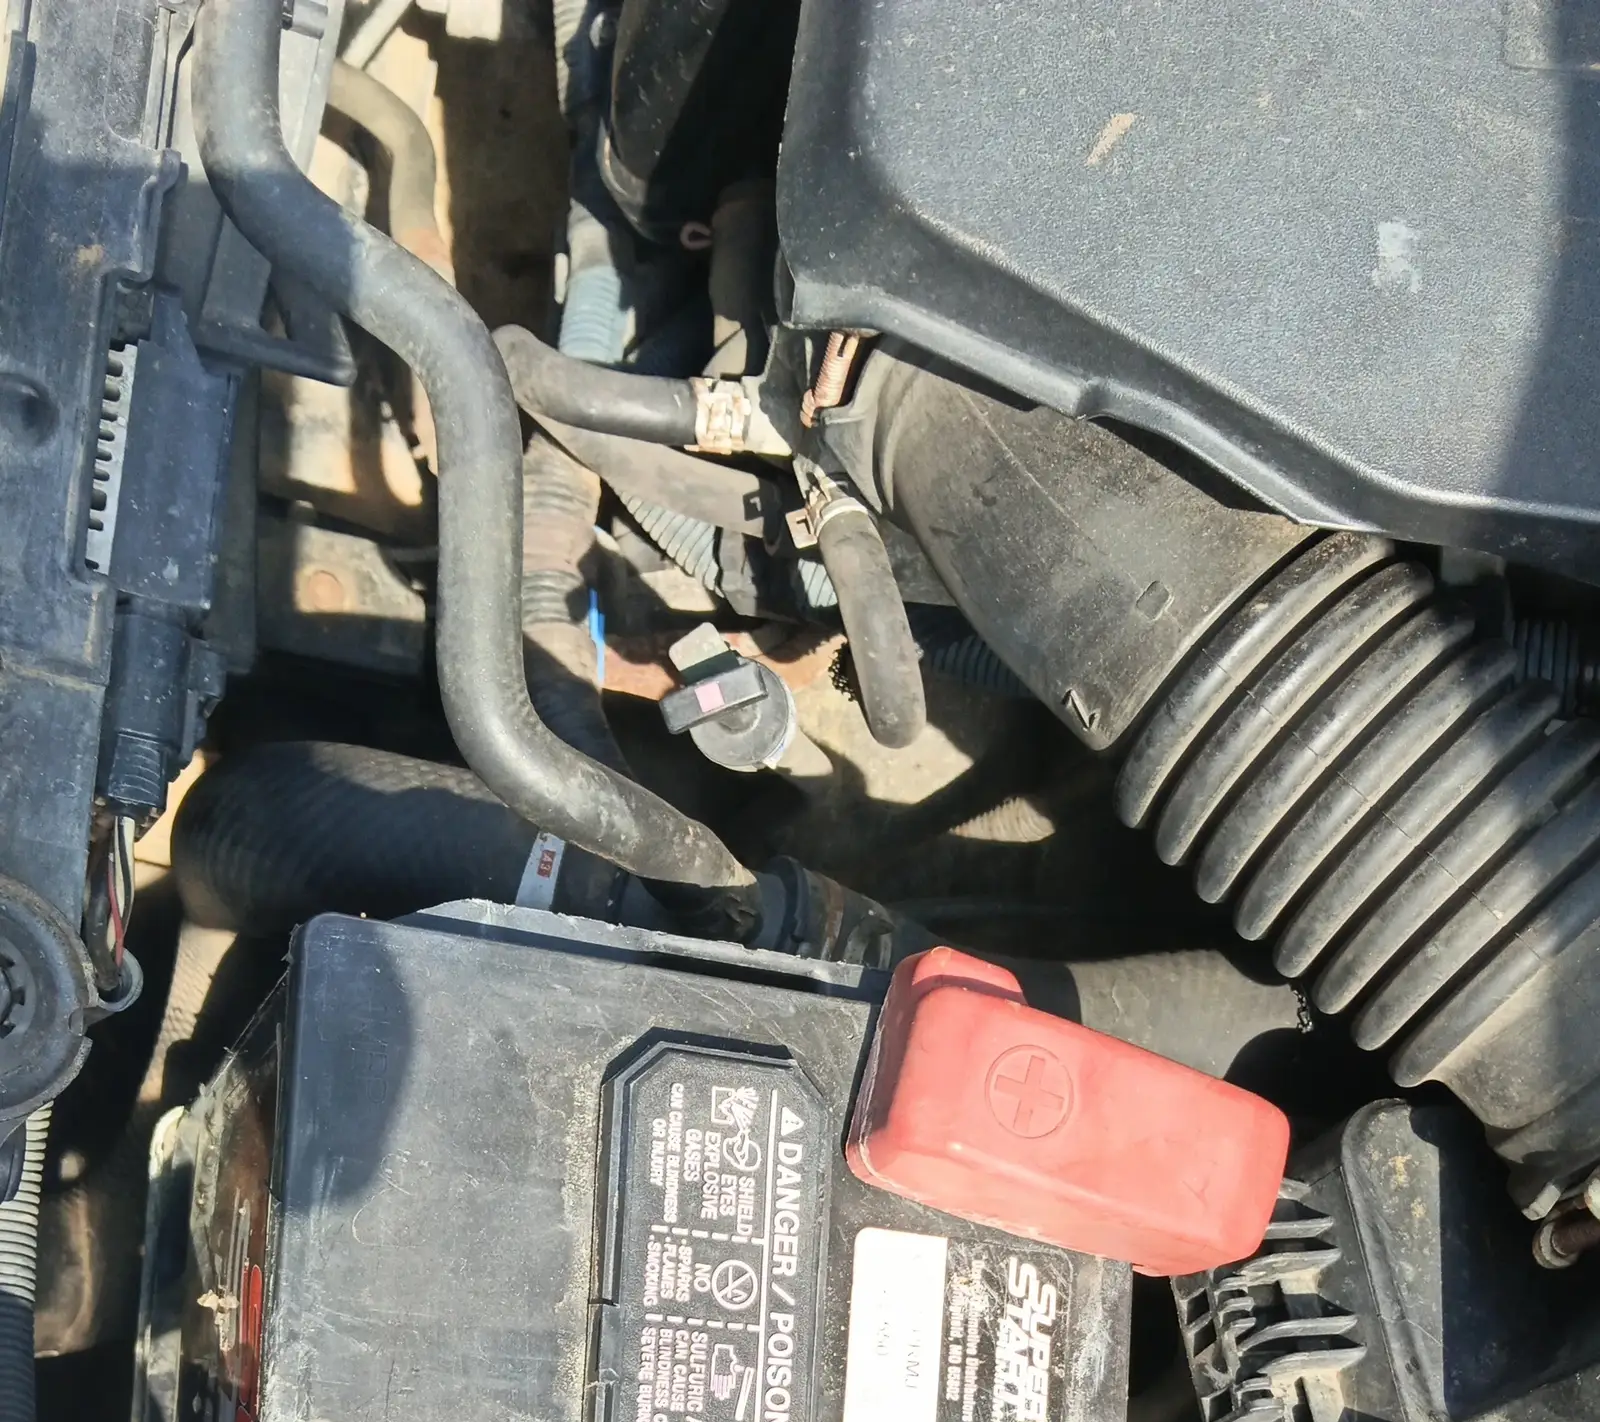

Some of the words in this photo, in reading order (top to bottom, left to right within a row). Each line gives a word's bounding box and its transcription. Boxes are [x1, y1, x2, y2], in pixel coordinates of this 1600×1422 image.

[670, 1083, 684, 1109] CAN
[652, 1118, 666, 1138] OR
[668, 1111, 683, 1152] CAUSE
[650, 1140, 665, 1186] INJURY
[684, 1129, 702, 1182] GASES
[700, 1131, 721, 1221] EXPLOSIVE
[663, 1155, 680, 1223] BLINDNESS
[720, 1174, 737, 1216] EYES
[736, 1176, 755, 1235] SHIELD
[771, 1141, 802, 1277] DANGER
[693, 1263, 711, 1292] NO
[638, 1327, 657, 1380] SEVERE
[675, 1330, 689, 1360] CAN
[948, 1344, 962, 1364] MO
[1003, 1256, 1040, 1422] START
[654, 1328, 673, 1408] BLINDNESS
[670, 1364, 687, 1412] CAUSE
[686, 1331, 708, 1413] SULFURIC
[962, 1357, 980, 1422] Distributors
